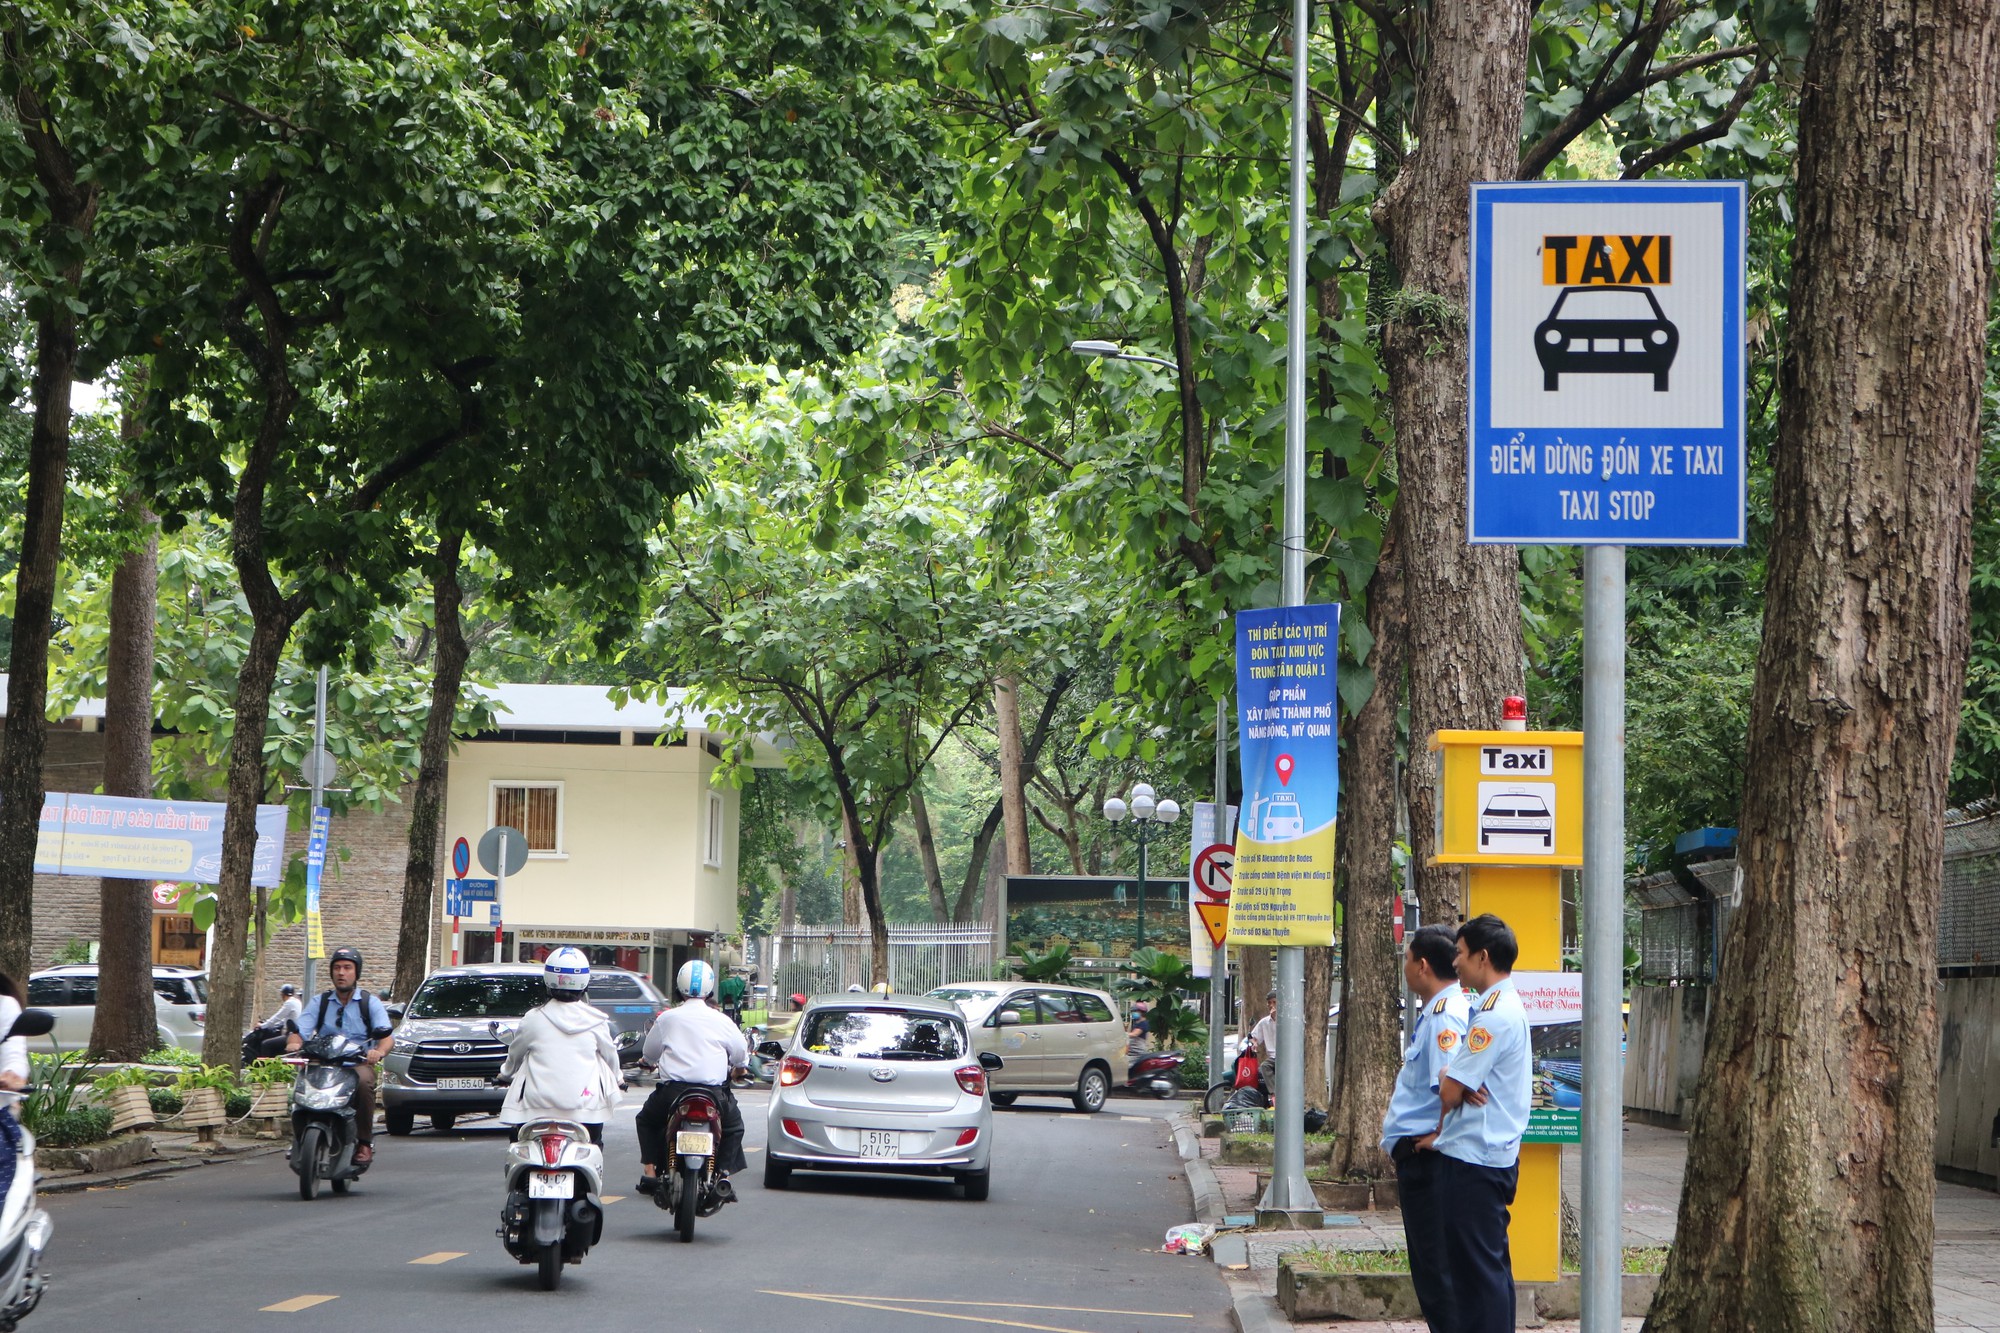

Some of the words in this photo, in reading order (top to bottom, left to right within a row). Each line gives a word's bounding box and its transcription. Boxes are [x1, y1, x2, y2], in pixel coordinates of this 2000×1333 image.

[1545, 235, 1671, 284] TAXI
[1490, 432, 1536, 474] ĐIỂM
[1545, 437, 1593, 474] DỪNG
[1601, 437, 1640, 475] ĐÓN
[1651, 445, 1673, 475] XE
[1683, 445, 1724, 475] TAXI
[1560, 490, 1599, 521] TAXI
[1609, 490, 1656, 521] STOP
[1248, 626, 1261, 641] THÍ
[1263, 621, 1283, 640] ĐIỂM
[1285, 623, 1301, 639] CÁC
[1304, 625, 1311, 640] VỊ
[1314, 622, 1328, 638] TRÍ
[1251, 645, 1269, 660] ĐÓN
[1271, 646, 1286, 659] TAXI
[1289, 645, 1305, 658] KHU
[1307, 642, 1325, 660] VỰC
[1250, 666, 1276, 679] TRUNG
[1277, 661, 1293, 677] TÂM
[1295, 661, 1318, 678] QUẬN
[1321, 663, 1326, 676] 1
[1269, 687, 1280, 702] GÓP
[1282, 684, 1306, 701] PHẦN
[1246, 706, 1263, 721] XÂY
[1264, 706, 1279, 721] DỰNG
[1282, 704, 1311, 719] THÀNH
[1313, 701, 1332, 718] PHỐ
[1248, 725, 1267, 739] NĂNG
[1291, 722, 1304, 737] MỸ
[1307, 724, 1331, 738] QUAN
[1483, 748, 1546, 769] Taxi
[1262, 854, 1288, 863] Alexandre
[1289, 854, 1295, 862] De
[1297, 854, 1312, 863] Rodes
[1277, 887, 1291, 898] Trọng
[1260, 903, 1269, 911] 139
[1290, 903, 1296, 911] Du
[536, 930, 556, 939] VISITOR
[557, 930, 592, 940] INFORMATION
[593, 930, 605, 940] AND
[1534, 987, 1557, 999] nhập
[1559, 986, 1580, 997] khẩu
[1536, 999, 1554, 1012] Việt
[1556, 999, 1583, 1010] Nam
[870, 1132, 891, 1145] 51G
[861, 1144, 898, 1157] 214.77
